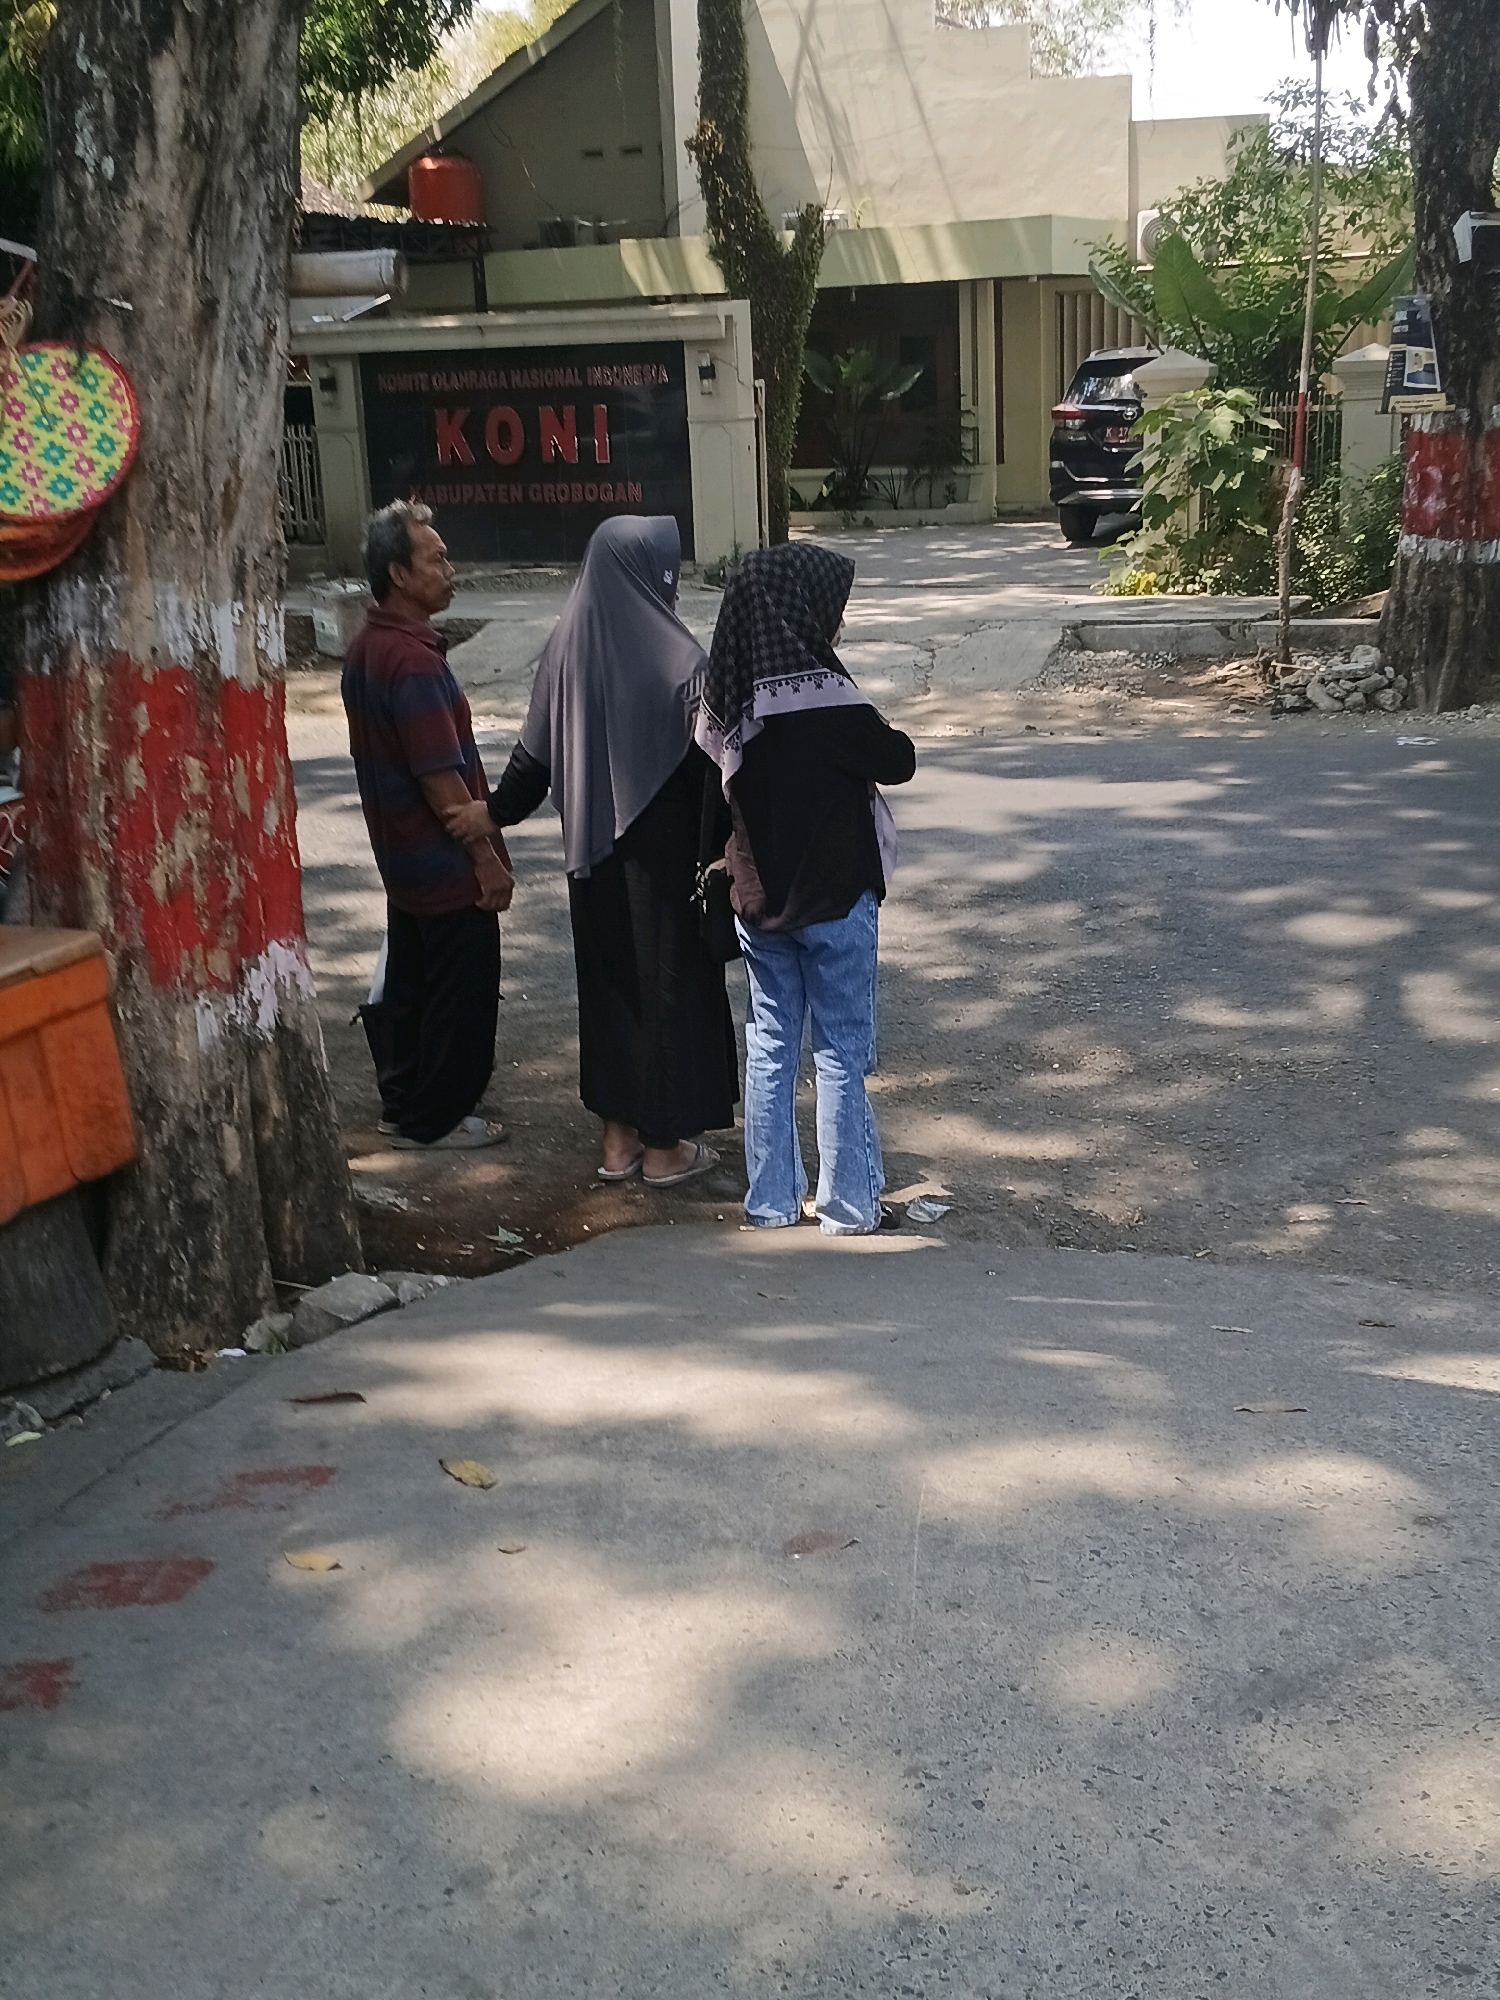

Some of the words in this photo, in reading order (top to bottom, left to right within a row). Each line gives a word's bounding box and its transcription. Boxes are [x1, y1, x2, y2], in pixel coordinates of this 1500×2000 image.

[378, 372, 429, 393] KOMITE
[431, 370, 508, 391] OLAHRAGA
[511, 368, 583, 389] NASIONAL
[586, 364, 669, 386] INDONESIA
[434, 404, 611, 464] KONI
[409, 484, 523, 503] KABUPATEN
[528, 482, 642, 503] GROBOGAN
